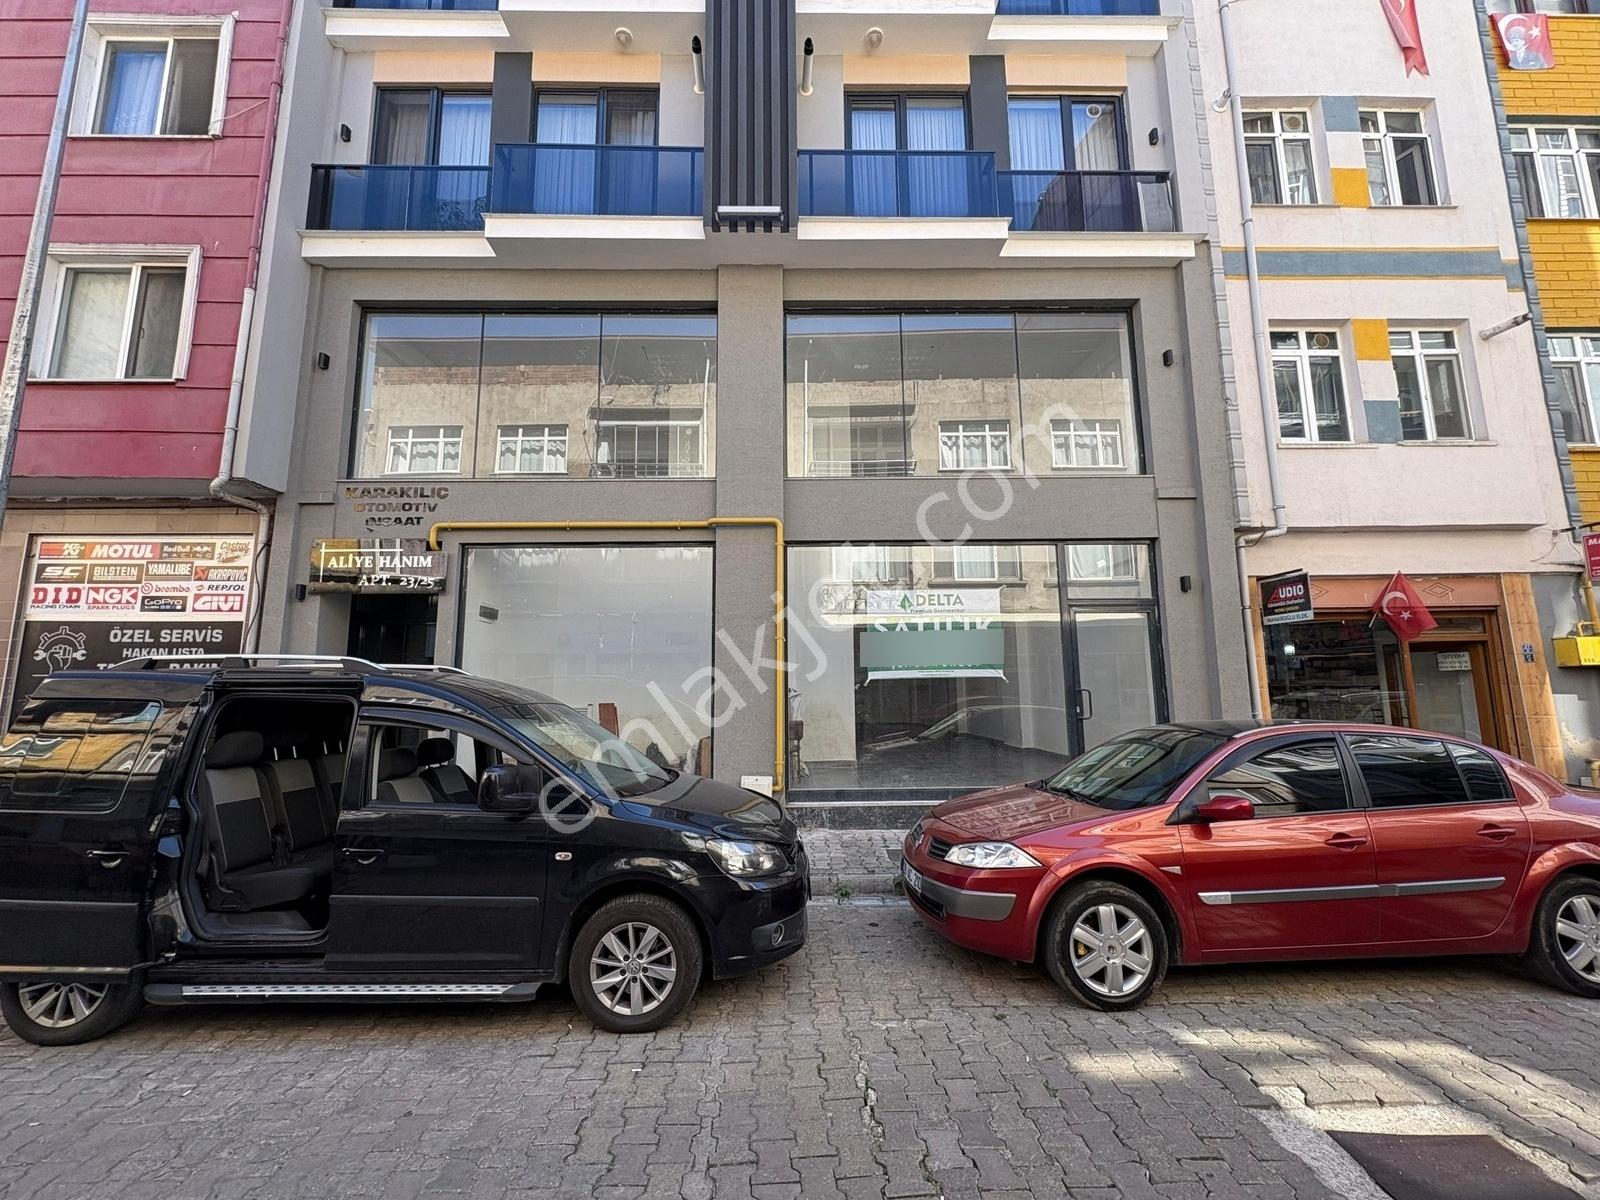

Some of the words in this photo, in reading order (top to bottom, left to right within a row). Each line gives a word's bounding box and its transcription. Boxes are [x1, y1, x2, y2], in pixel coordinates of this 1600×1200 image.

[91, 544, 153, 559] MOTUL
[220, 541, 250, 553] Castrol
[328, 554, 374, 568] ALİYE
[379, 556, 432, 568] HANIM
[42, 566, 83, 576] SC
[94, 566, 138, 576] BILSTEIN
[148, 562, 192, 575] YAMALUBE
[358, 574, 392, 587] APT.
[400, 576, 435, 588] 23/25
[154, 584, 190, 593] brembo
[1269, 584, 1304, 601] AUDIO
[87, 588, 137, 604] NGK
[144, 598, 183, 606] GoPro
[193, 595, 241, 611] GIVI
[915, 593, 964, 607] DELTA
[109, 626, 154, 642] ÖZEL
[160, 626, 223, 642] SERVİS
[122, 647, 168, 658] HAKAN
[172, 647, 205, 656] USTA
